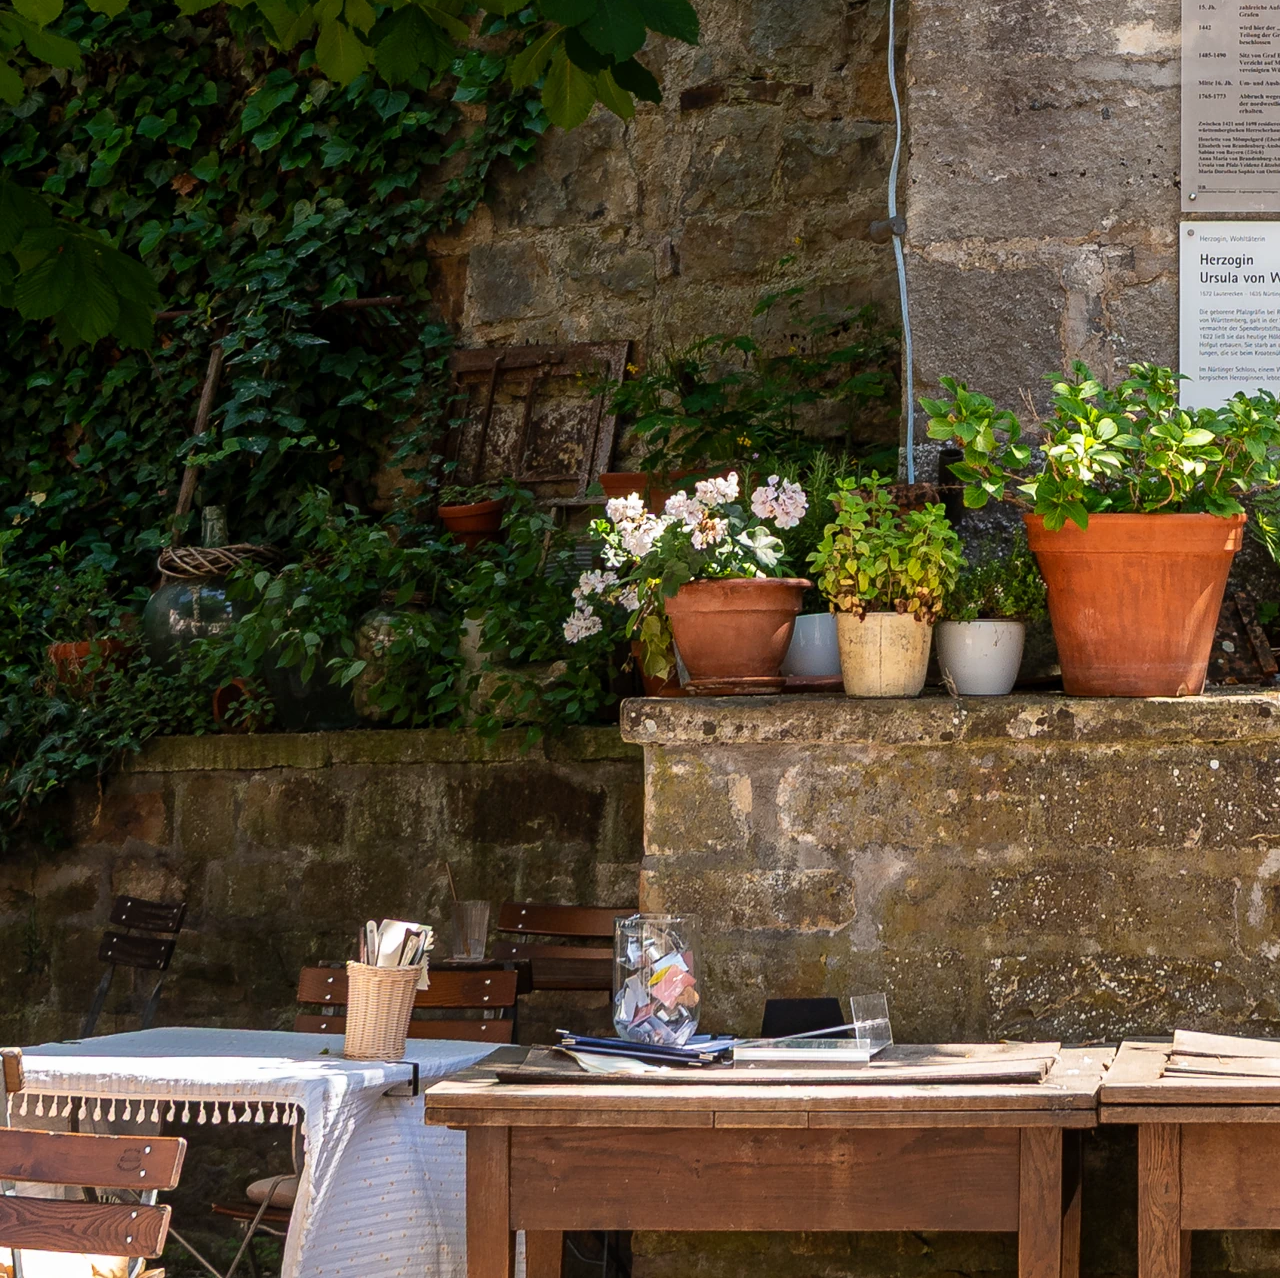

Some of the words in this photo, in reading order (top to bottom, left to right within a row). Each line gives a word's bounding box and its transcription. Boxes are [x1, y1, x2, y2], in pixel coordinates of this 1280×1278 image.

[1200, 235, 1228, 243] Herzogin,
[1200, 254, 1253, 268] Herzogin
[1200, 272, 1238, 284] Ursula
[1244, 274, 1265, 284] von
[1246, 333, 1267, 341] heutige
[1199, 374, 1228, 382] bergischen
